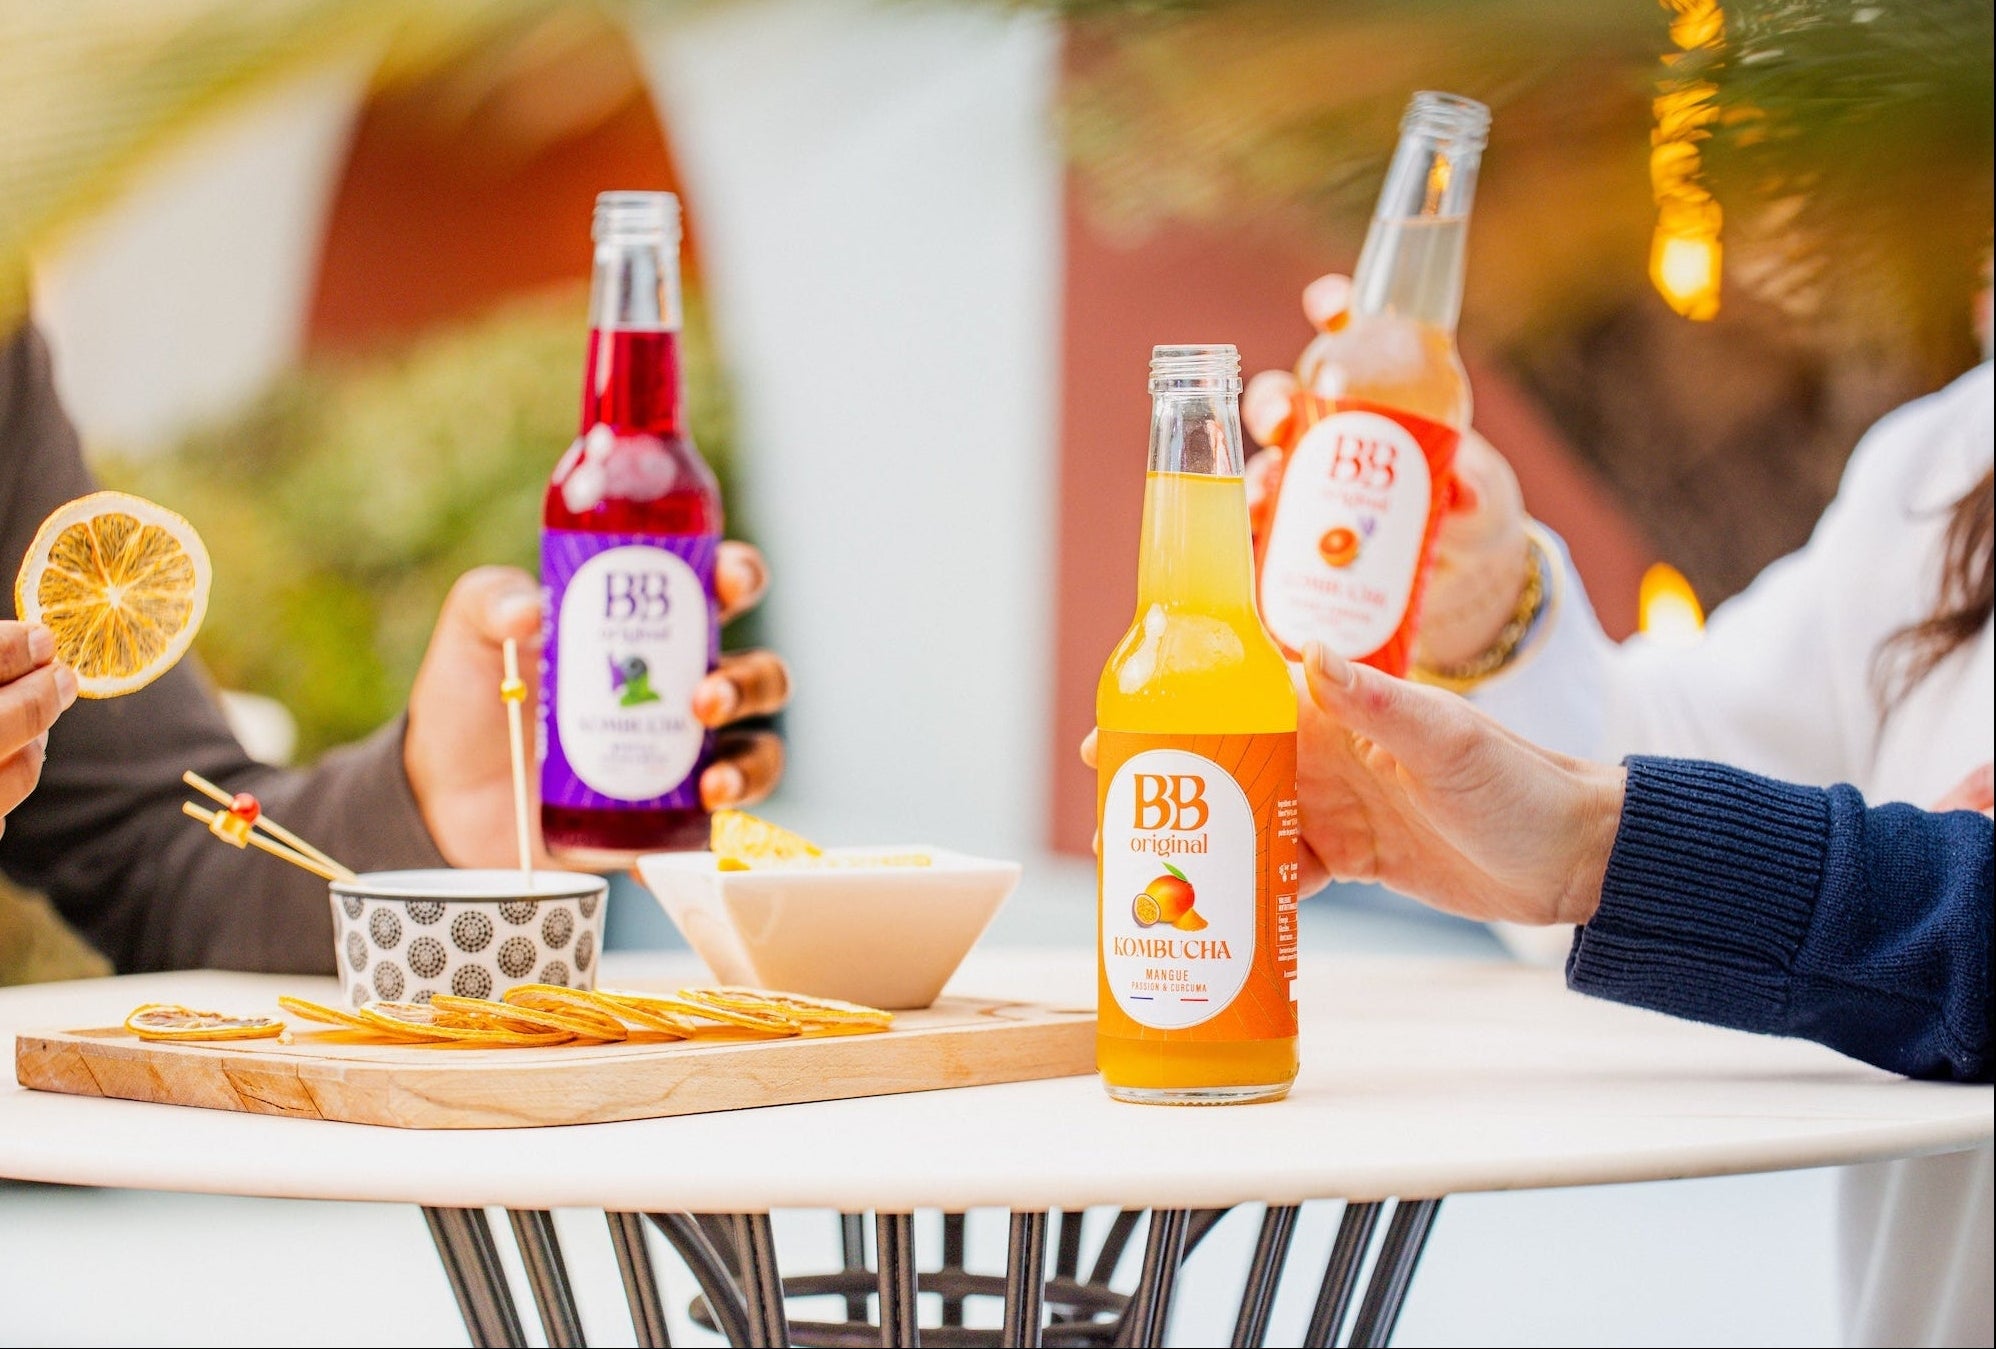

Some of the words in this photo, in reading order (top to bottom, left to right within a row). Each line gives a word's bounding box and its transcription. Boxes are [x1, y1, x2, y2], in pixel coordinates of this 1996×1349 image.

[1330, 434, 1398, 490] BB
[604, 571, 671, 620] BB
[1133, 773, 1209, 831] BB
[1130, 833, 1208, 858] original
[1114, 936, 1232, 960] KOMBUCHA
[1131, 981, 1160, 992] PASSION
[1162, 983, 1168, 992] &
[1170, 983, 1208, 993] CURCUMA
[1145, 968, 1189, 981] MANGUE
